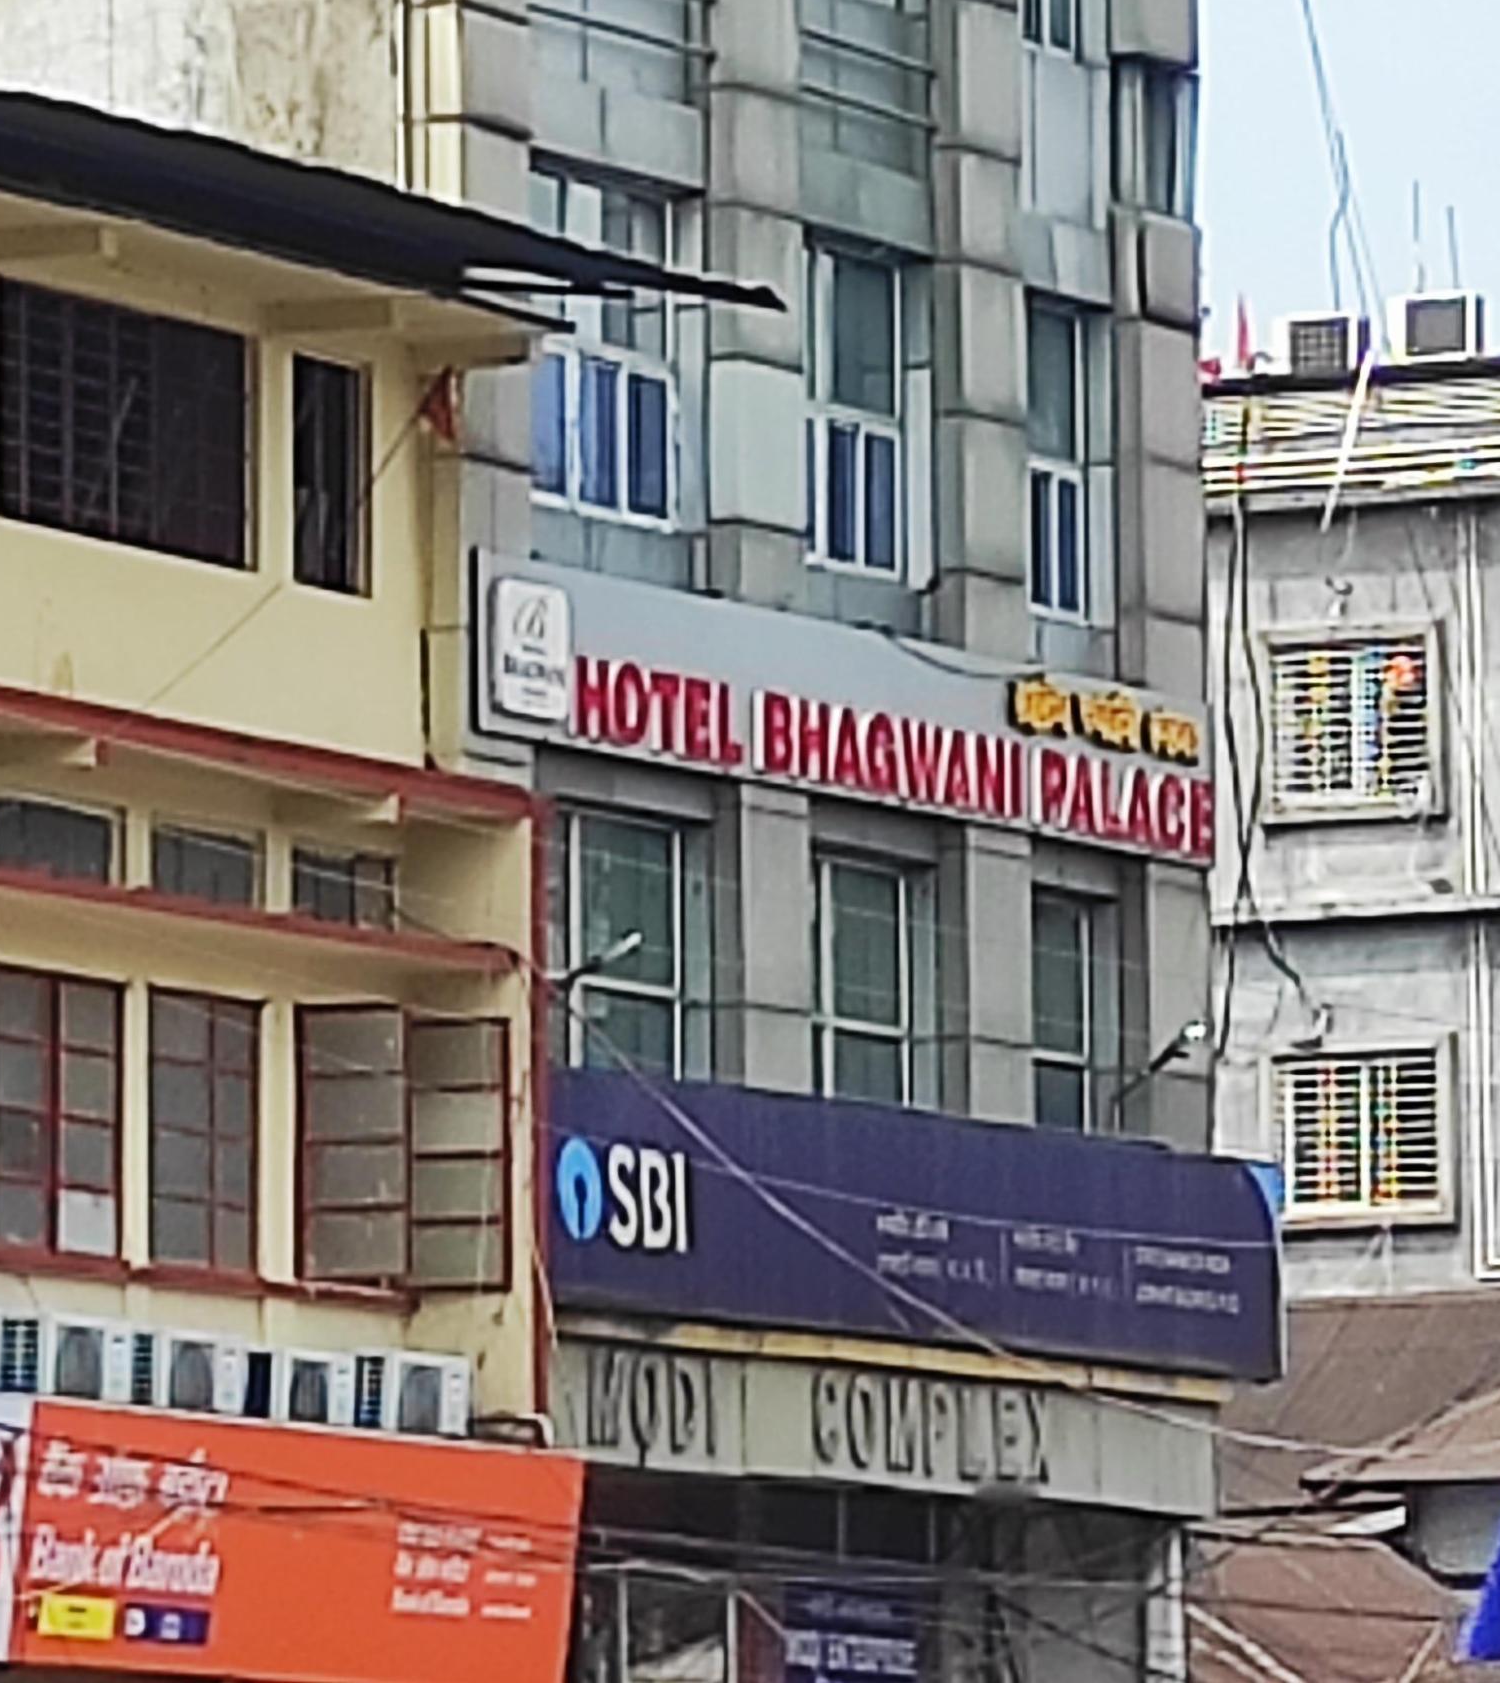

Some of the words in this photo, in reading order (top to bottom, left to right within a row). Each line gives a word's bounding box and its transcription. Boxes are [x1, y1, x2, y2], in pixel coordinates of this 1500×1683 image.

[569, 654, 744, 767] HOTEL
[751, 688, 1022, 820] BHAGWANI
[1031, 747, 1214, 860] PALACE
[607, 1142, 688, 1253] SBI
[811, 1368, 1049, 1484] COMPLEX
[29, 1523, 99, 1585] Bank
[97, 1532, 132, 1588] of
[125, 1534, 220, 1596] Baroda
